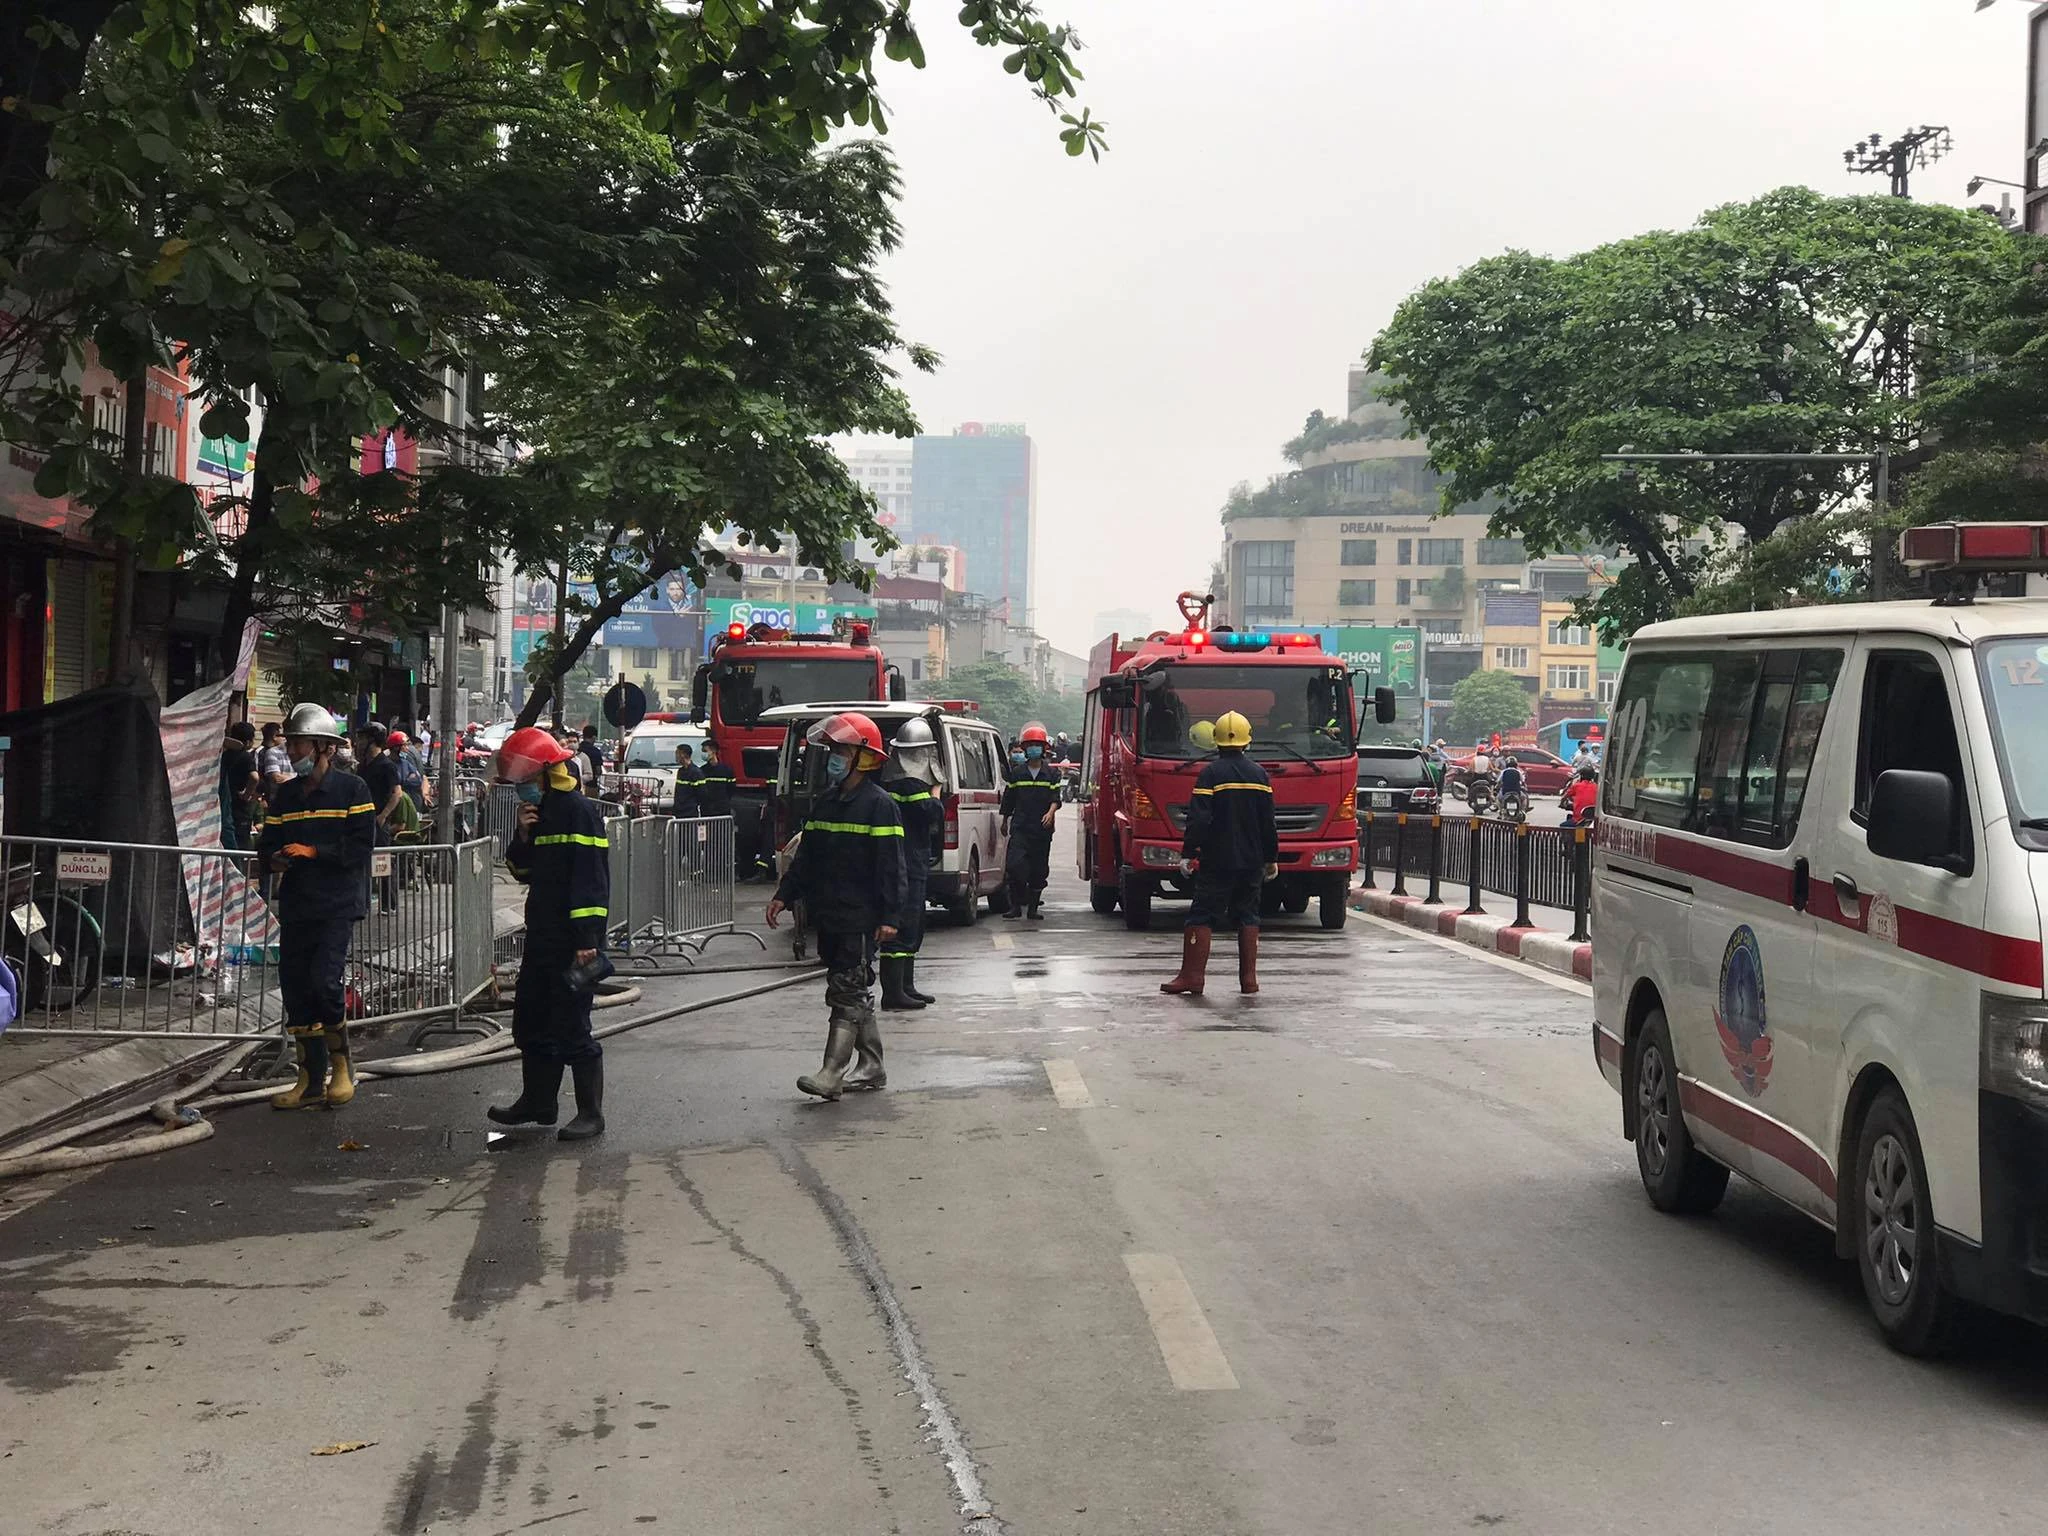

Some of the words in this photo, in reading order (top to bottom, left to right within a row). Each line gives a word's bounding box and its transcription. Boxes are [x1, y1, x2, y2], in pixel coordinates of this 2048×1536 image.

[1340, 522, 1384, 533] DREAM
[1425, 632, 1483, 644] MOUNTAIN
[1394, 642, 1413, 650] MILO
[1328, 668, 1343, 680] P.2
[2000, 659, 2044, 685] 12
